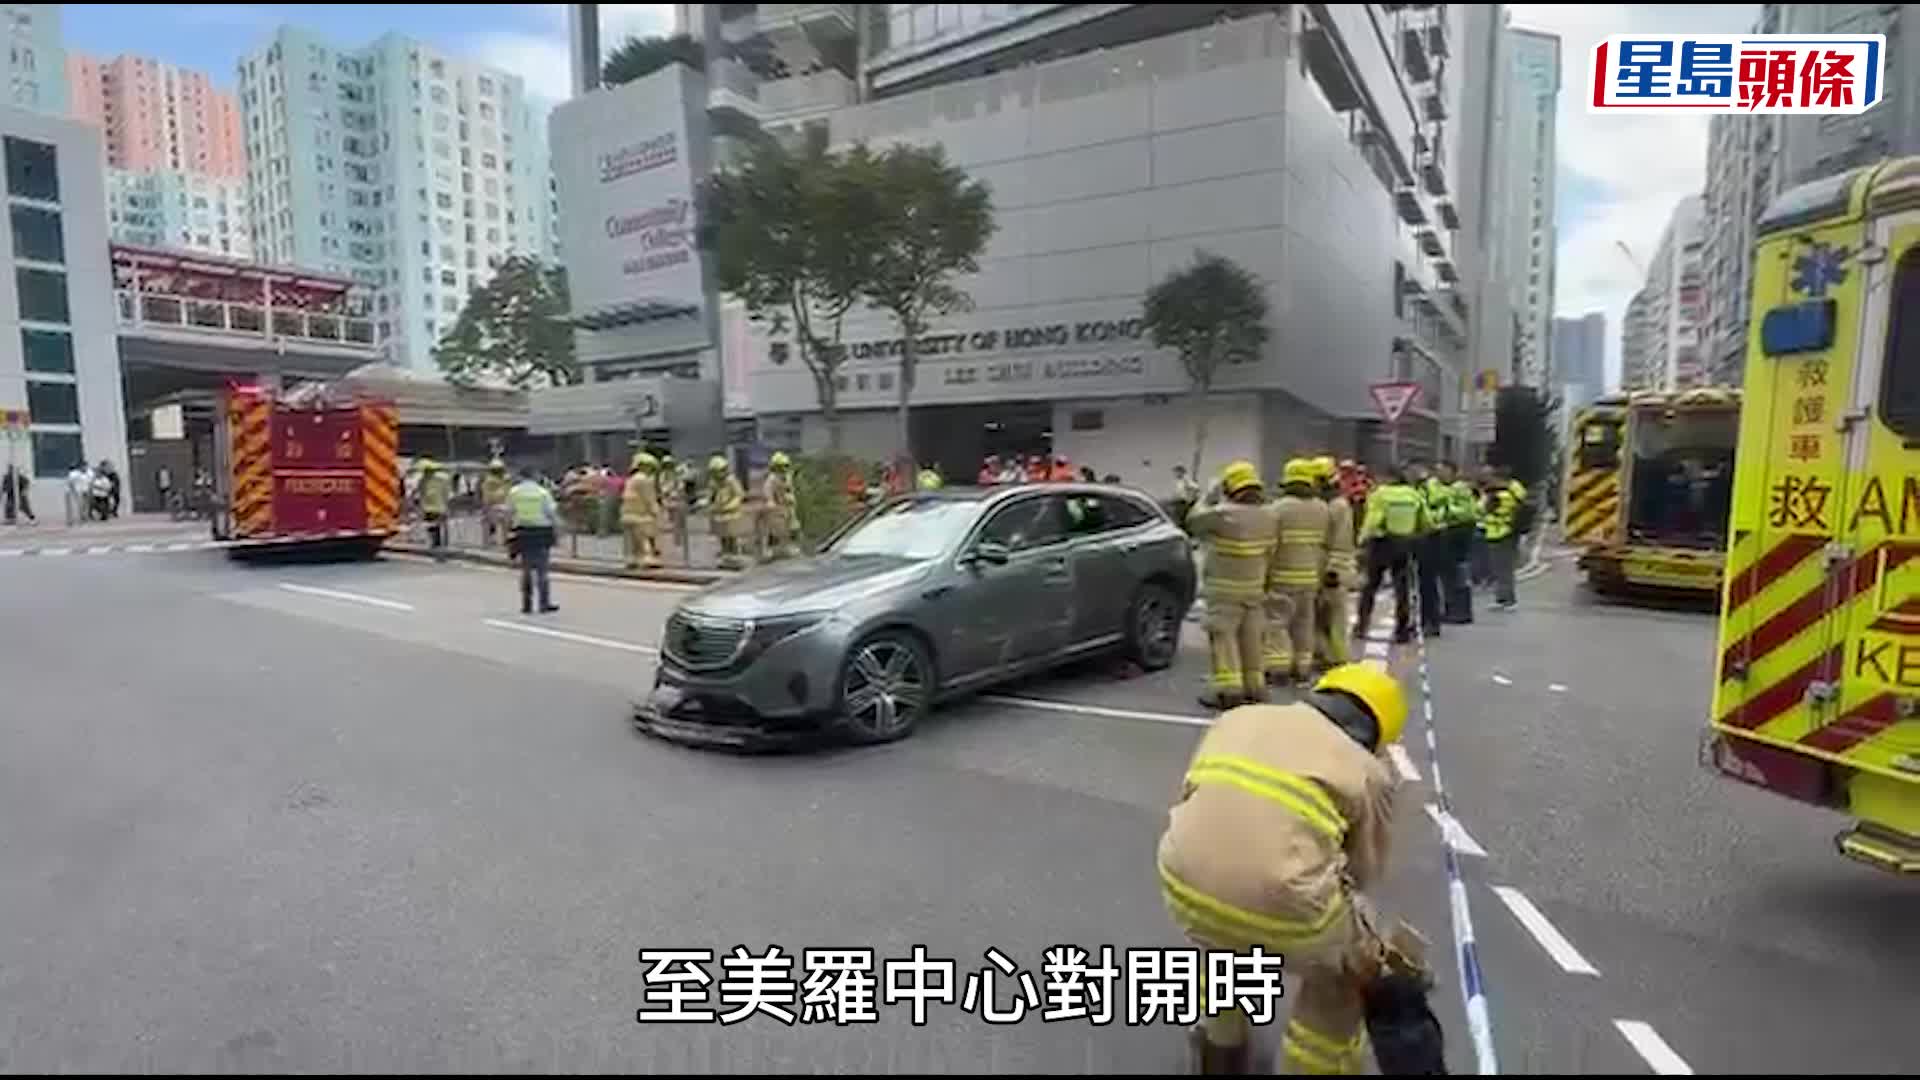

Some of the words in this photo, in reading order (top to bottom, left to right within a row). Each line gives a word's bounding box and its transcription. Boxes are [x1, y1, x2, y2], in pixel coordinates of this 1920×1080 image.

[969, 329, 998, 350] OF
[1004, 324, 1069, 349] HONG
[1074, 318, 1145, 343] KONG
[1768, 474, 1832, 530] 救
